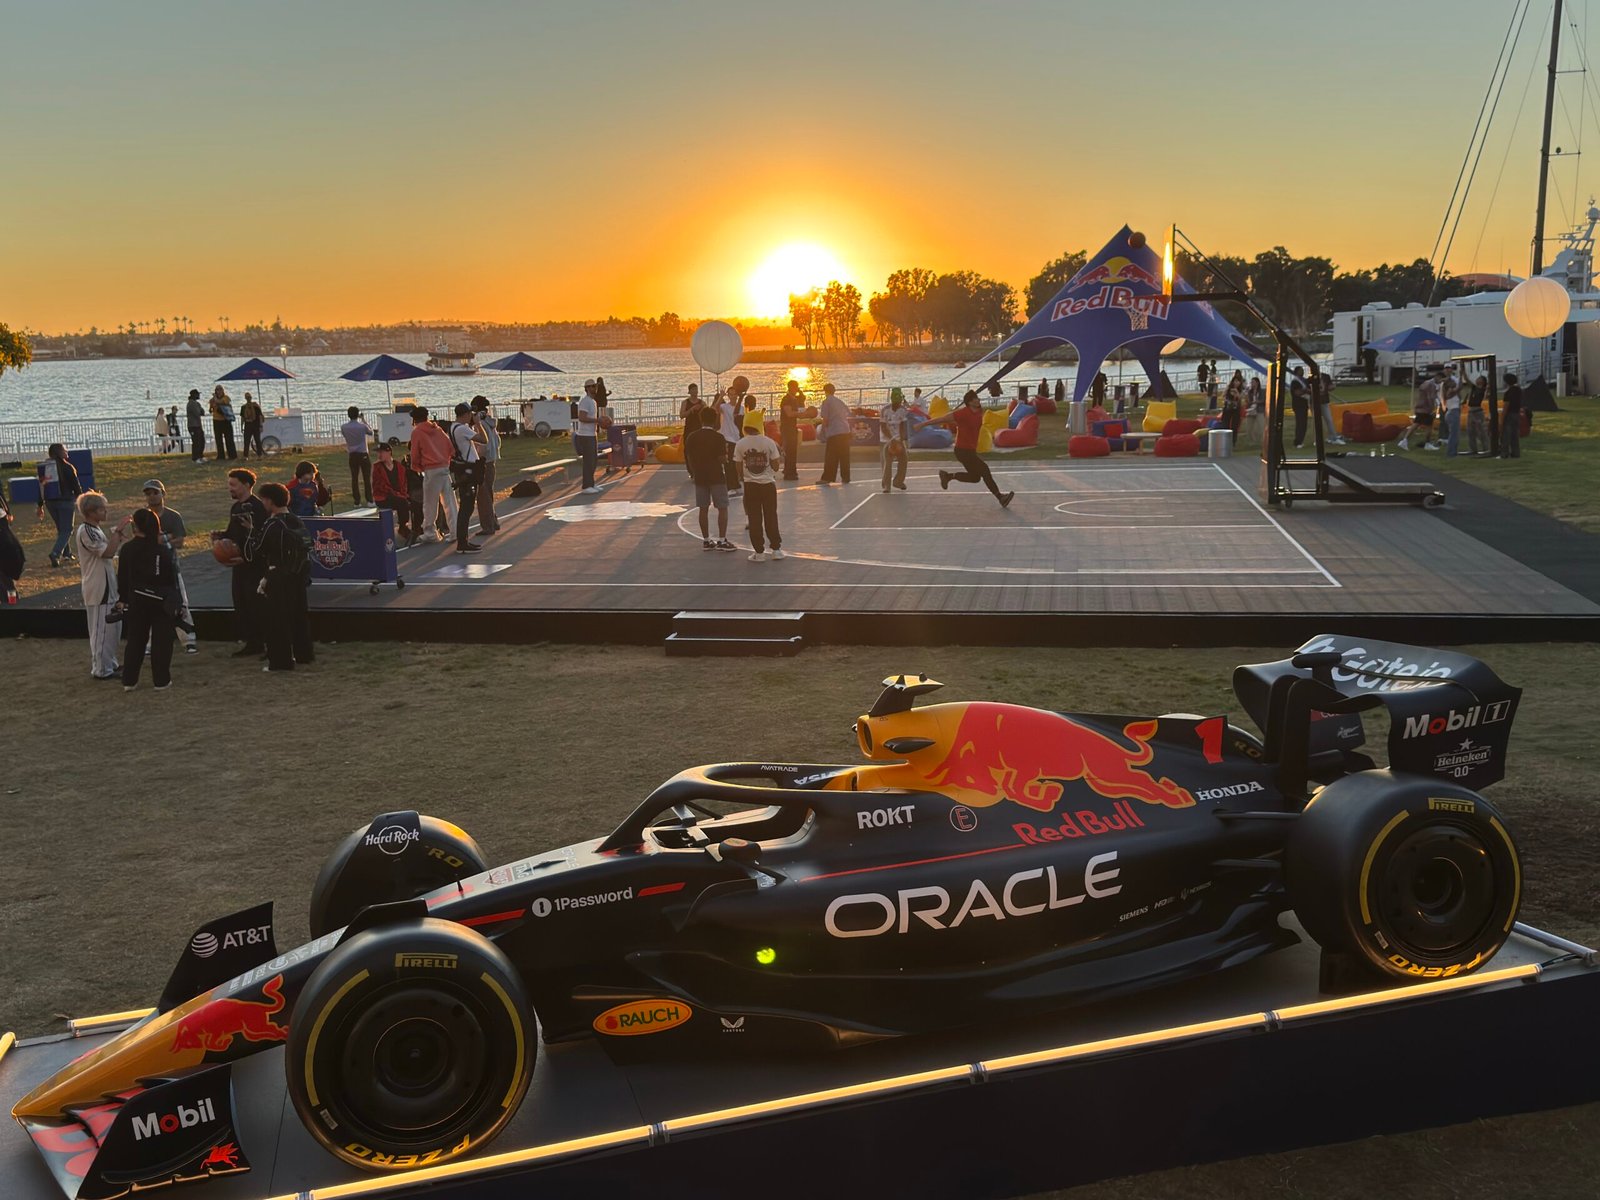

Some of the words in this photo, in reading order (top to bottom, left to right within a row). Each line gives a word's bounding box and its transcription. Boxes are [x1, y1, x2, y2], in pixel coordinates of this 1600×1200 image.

[1051, 285, 1109, 322] Red
[1402, 705, 1481, 740] Mobil
[1194, 716, 1224, 764] 1
[760, 765, 799, 773] AVATRADE
[1437, 750, 1488, 767] Heineken
[1195, 781, 1265, 801] HONDA
[857, 805, 915, 830] ROKT
[1428, 797, 1475, 814] PIRELLI
[1011, 812, 1086, 845] Red
[1074, 800, 1145, 835] Bull
[365, 832, 393, 846] Hard
[393, 828, 420, 844] Rock
[554, 886, 633, 911] 1Password
[824, 850, 1123, 938] ORACLE
[1119, 905, 1149, 922] SIEMENS
[223, 925, 271, 950] AT&T
[395, 952, 459, 969] PIRELLI
[1388, 953, 1462, 978] ZERO
[1466, 951, 1481, 970] P
[619, 1006, 680, 1028] RAUCH
[131, 1097, 216, 1141] Mobil
[344, 1142, 443, 1168] ZERO
[451, 1132, 470, 1154] P
